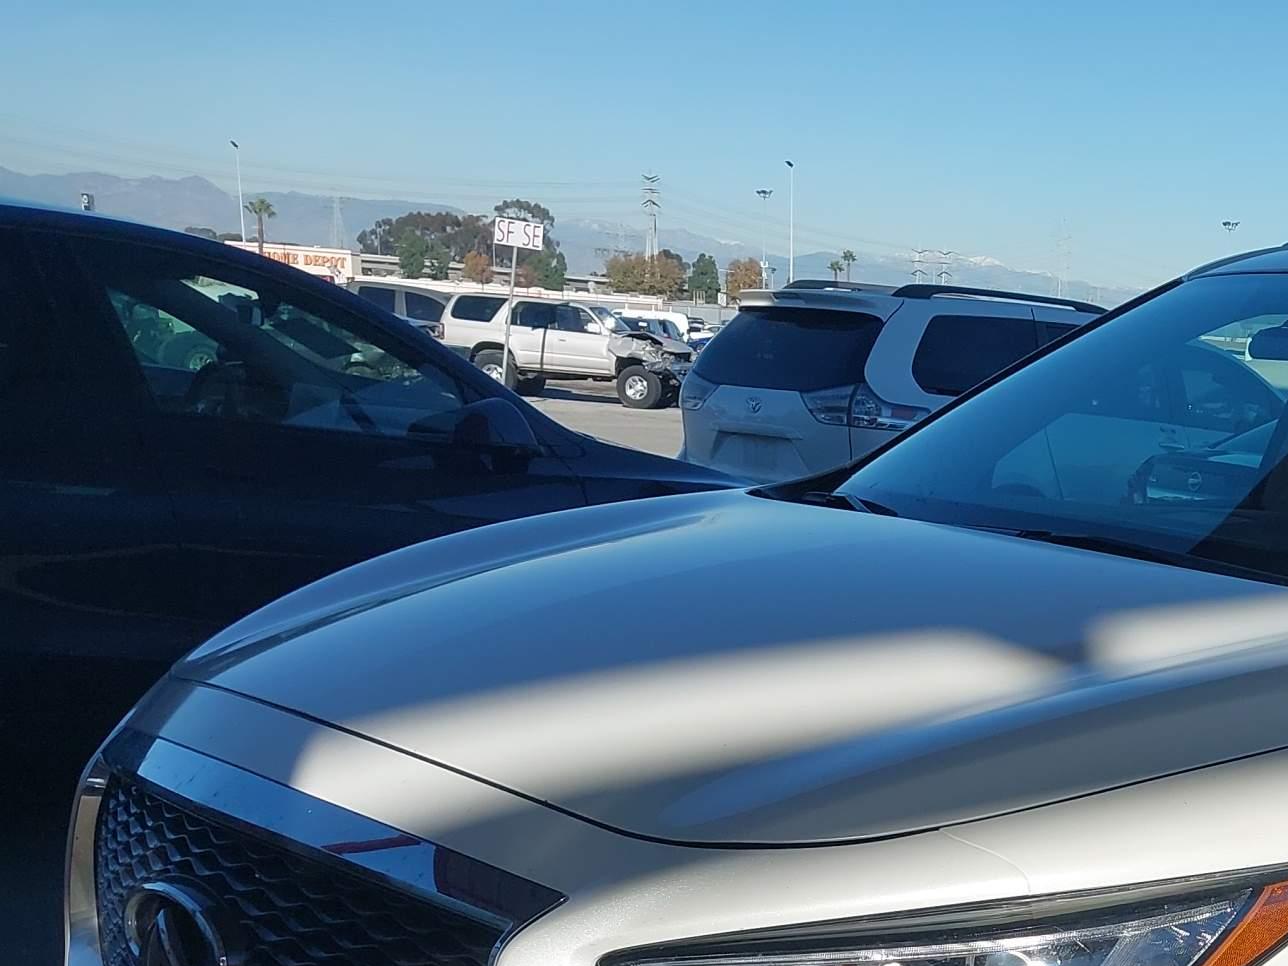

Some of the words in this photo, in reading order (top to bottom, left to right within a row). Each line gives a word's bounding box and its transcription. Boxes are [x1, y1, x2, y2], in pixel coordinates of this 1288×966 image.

[496, 219, 516, 244] SF
[522, 223, 542, 249] SE
[303, 254, 347, 269] DEPOT
